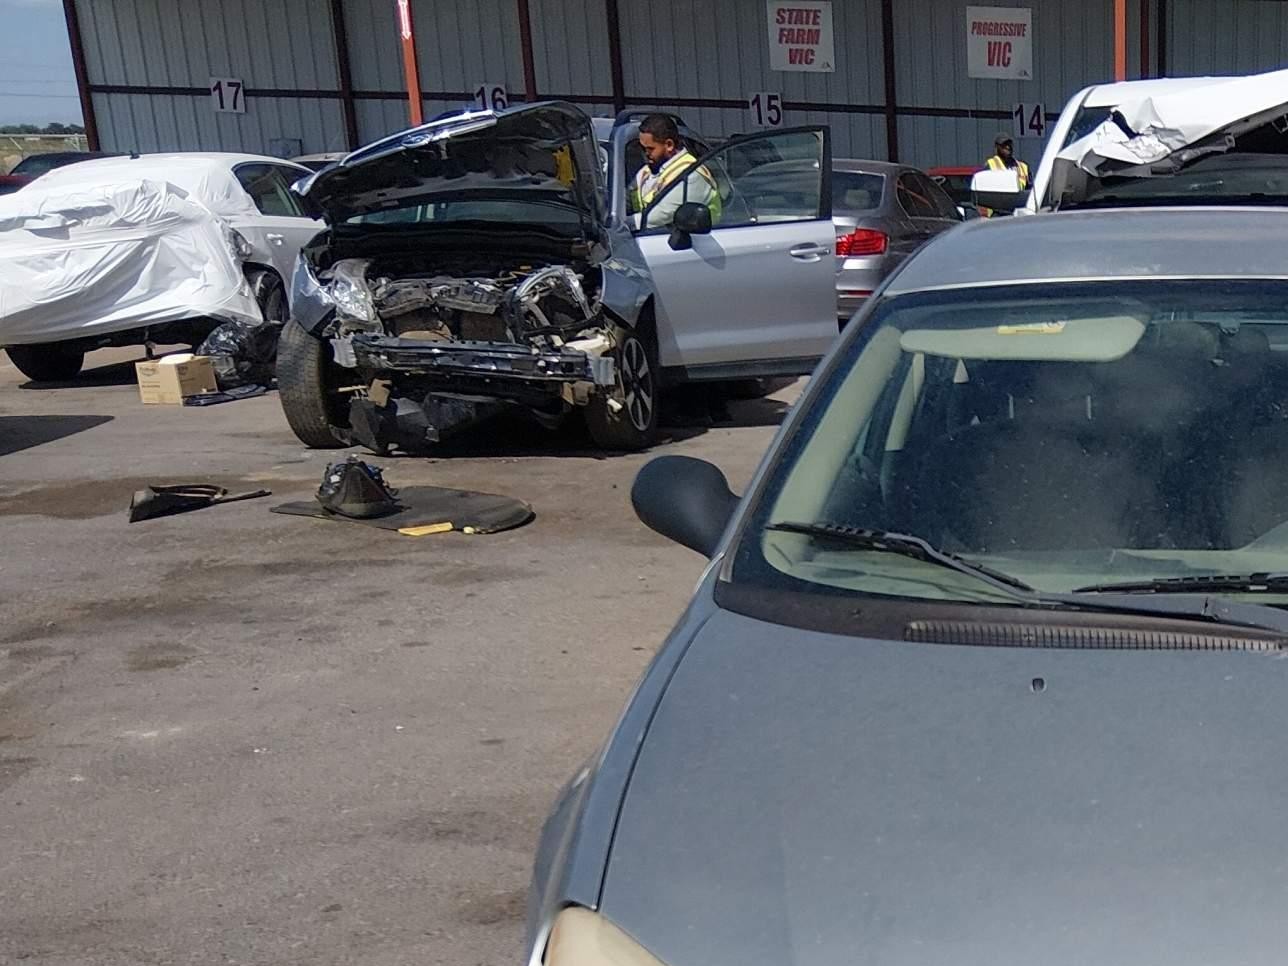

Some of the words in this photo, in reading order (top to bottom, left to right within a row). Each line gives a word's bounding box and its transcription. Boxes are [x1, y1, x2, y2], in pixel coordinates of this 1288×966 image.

[775, 7, 822, 26] STATE
[971, 20, 1027, 38] PROGRESSIVE
[778, 27, 821, 45] FARM
[788, 47, 816, 66] VIC
[987, 40, 1012, 68] VIC
[212, 80, 241, 110] 17
[475, 86, 507, 111] 16
[751, 94, 782, 126] 15
[1014, 103, 1044, 137] 14
